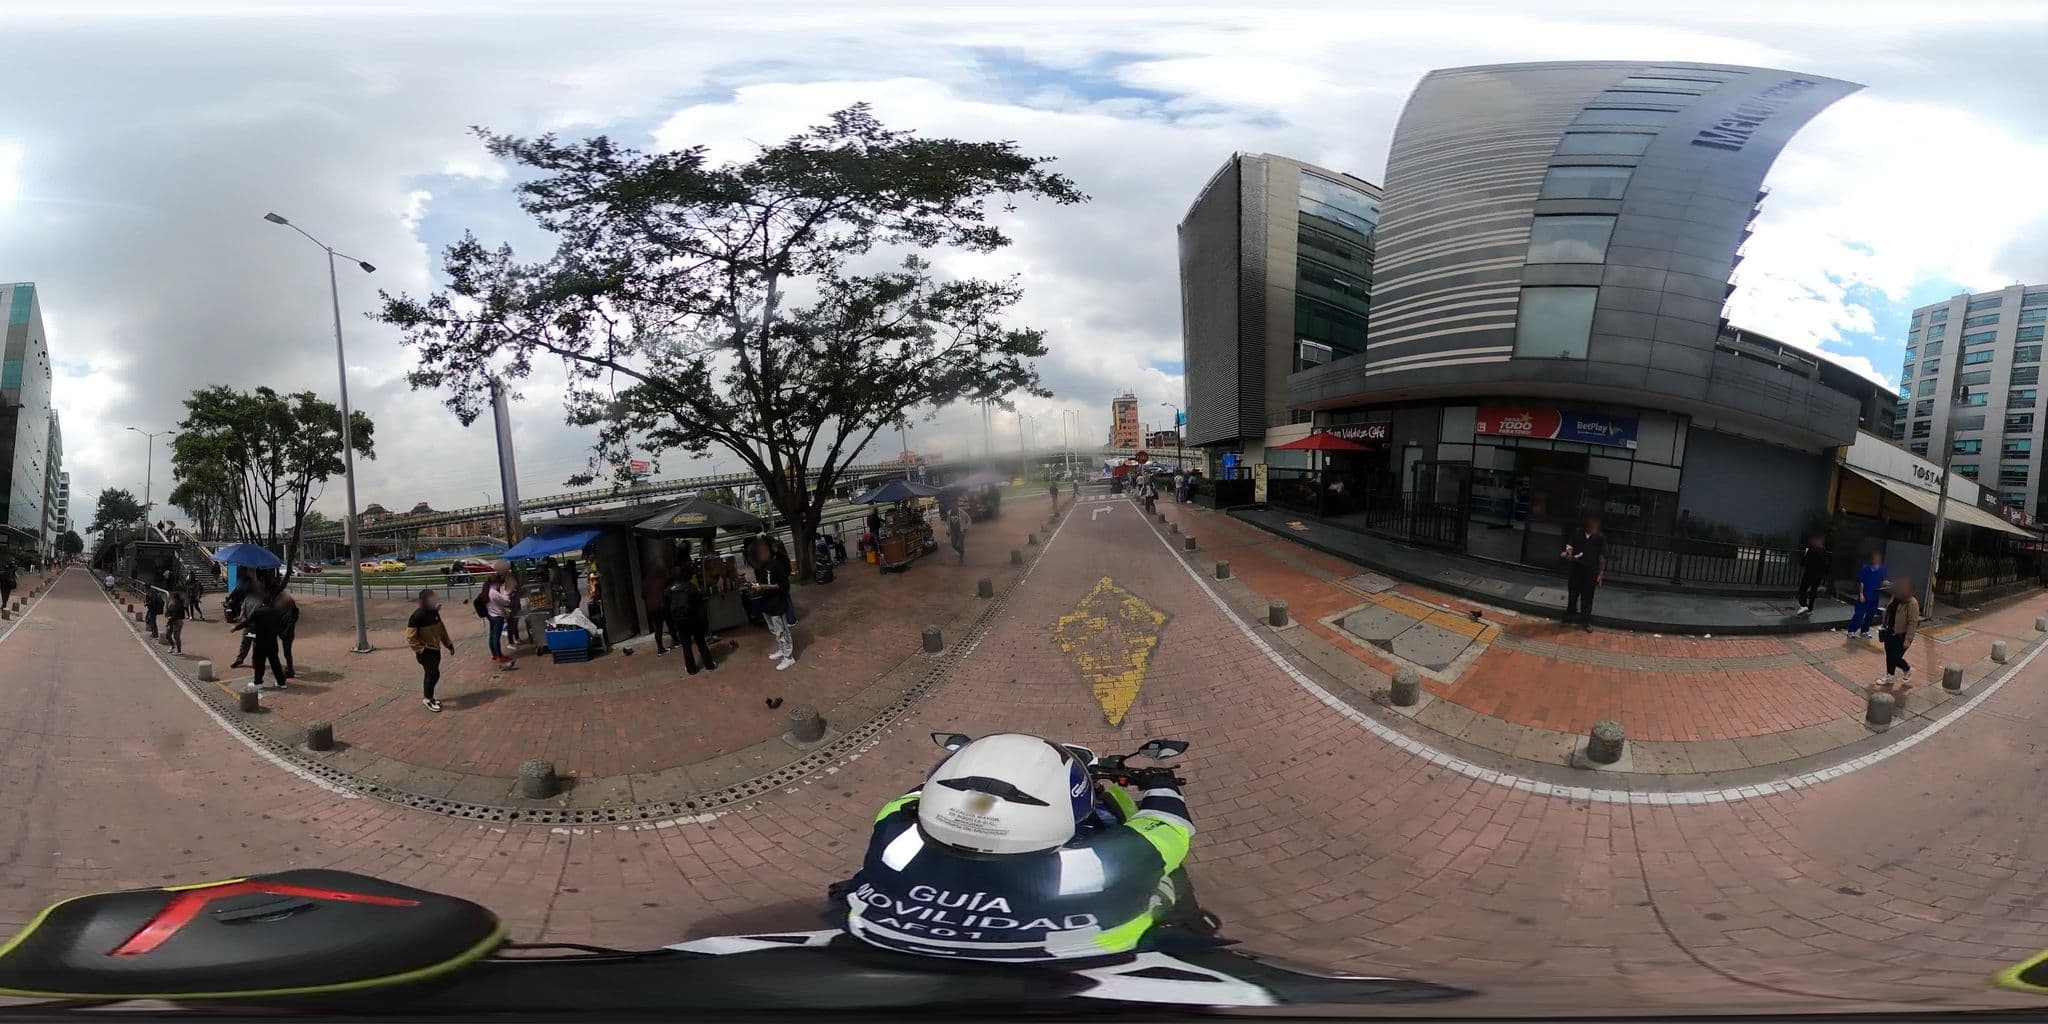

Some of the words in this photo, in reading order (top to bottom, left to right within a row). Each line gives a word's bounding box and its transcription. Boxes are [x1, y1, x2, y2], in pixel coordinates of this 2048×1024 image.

[1342, 427, 1368, 439] Valdez
[1368, 425, 1385, 439] Café
[1499, 420, 1532, 431] TODO
[1577, 421, 1608, 434] BetPlay
[1912, 464, 1942, 486] TOSTA
[855, 882, 1099, 931] MOVILIDAD
[908, 884, 1013, 914] GUÍA
